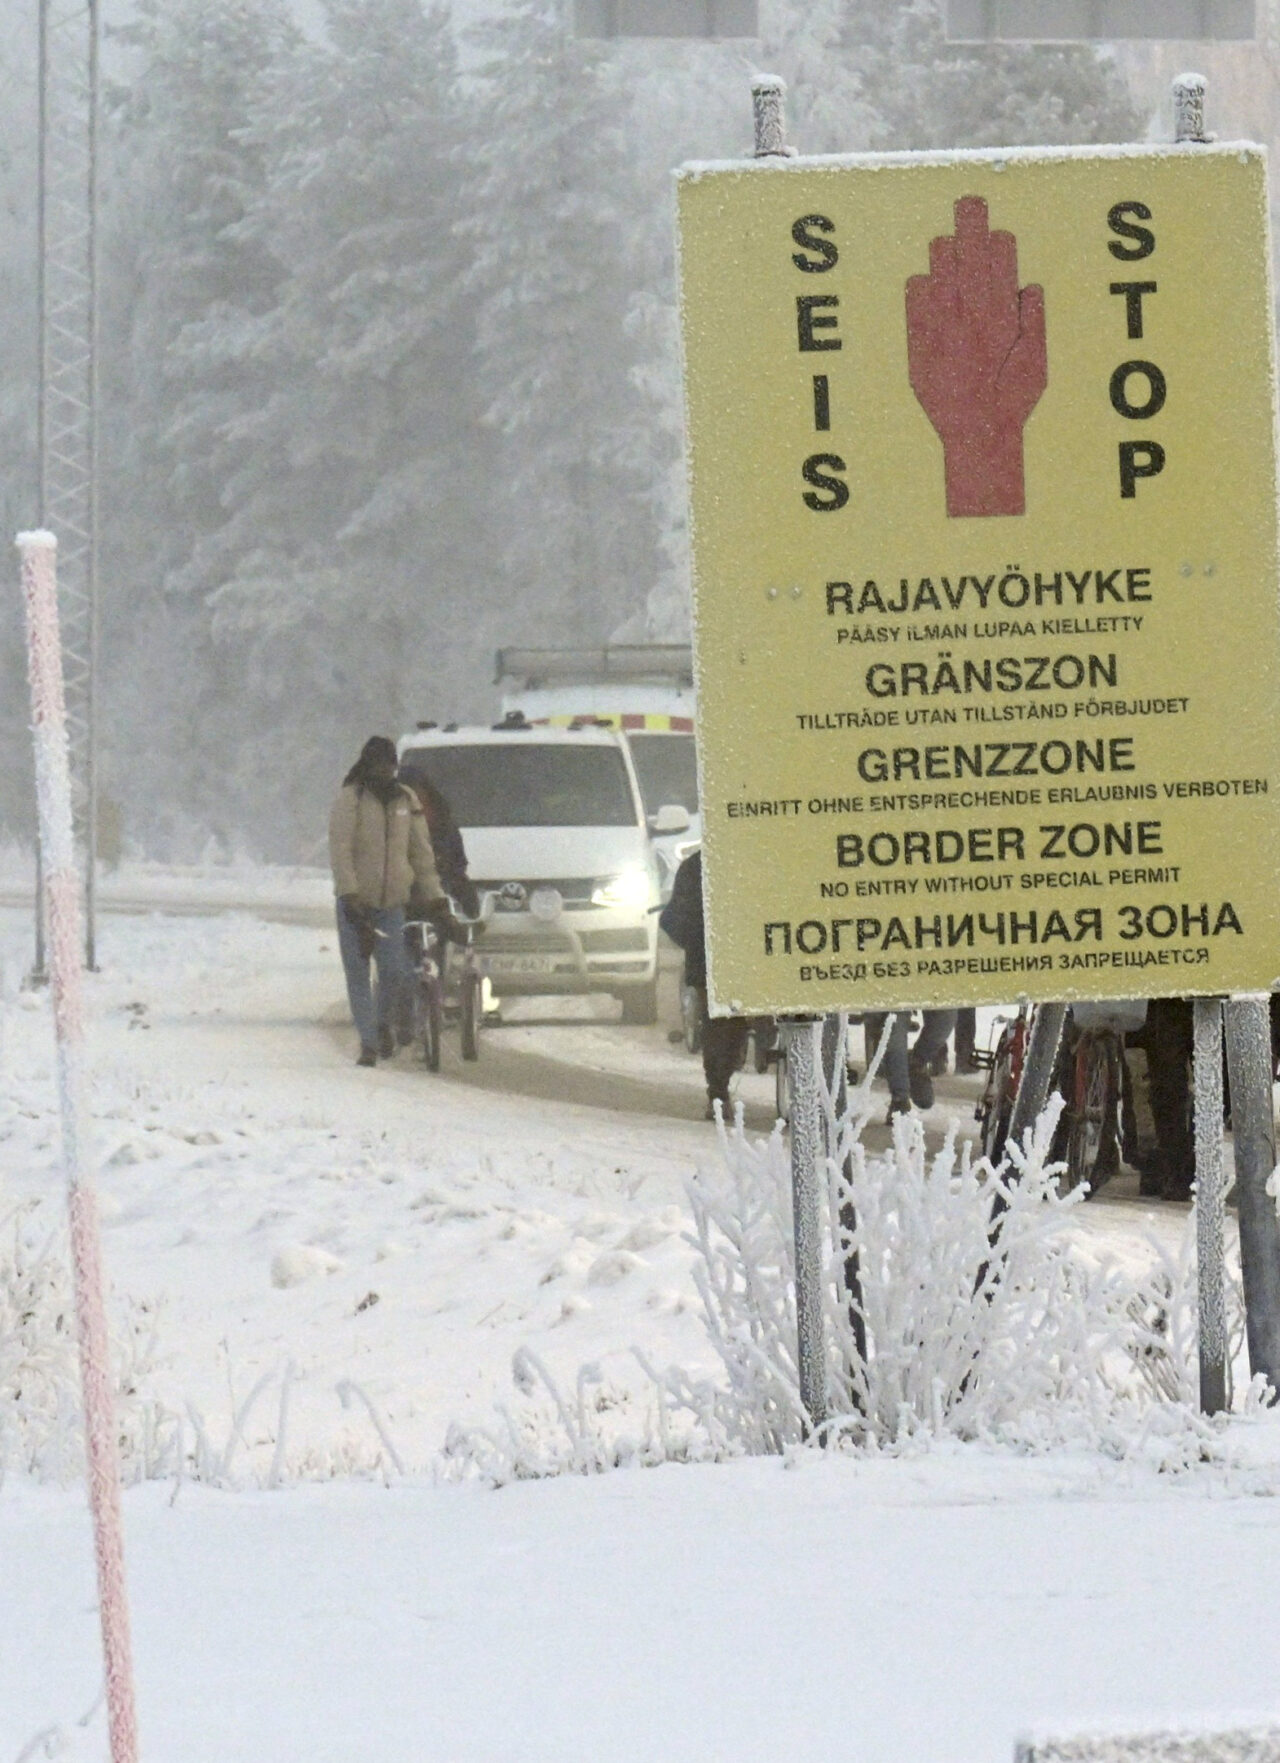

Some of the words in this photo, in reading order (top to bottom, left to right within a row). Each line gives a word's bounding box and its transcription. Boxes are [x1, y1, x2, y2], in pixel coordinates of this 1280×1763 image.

[791, 214, 850, 512] SEIS
[1107, 201, 1166, 499] STOP
[825, 565, 1153, 615] RAJAVYÖHYKE
[837, 625, 900, 644] PÄÄSY
[908, 622, 967, 641] ILMAN
[974, 620, 1036, 638] LUPAA
[1042, 616, 1143, 634] KIELLETTY
[865, 652, 1118, 697] GRÄNSZON
[796, 709, 899, 730] TILLTRÄDE
[905, 708, 957, 725] UTAN
[963, 700, 1068, 723] TILLSTÅND
[1074, 698, 1190, 718] FÖRBJUDET
[857, 738, 1135, 783] GRENZZONE
[727, 800, 802, 818] EINRITT
[808, 797, 864, 814] OHNE
[870, 789, 1040, 812] ENTSPRECHENDE
[1047, 784, 1157, 804] ERLAUBNIS
[1163, 778, 1269, 799] VERBOTEN
[837, 827, 1025, 868] BORDER
[1039, 821, 1164, 859] ZONE
[820, 881, 849, 898] NO
[856, 878, 918, 896] ENTRY
[925, 874, 1013, 894] WITHOUT
[1021, 870, 1103, 890] SPECIAL
[1108, 867, 1181, 886] PERMIT
[764, 907, 1103, 955] ПОГРАНИЧНАЯ
[1117, 902, 1244, 940] ЗОНА
[800, 961, 867, 982] ВЪЕЗД
[873, 959, 911, 978] БЕЗ
[917, 953, 1053, 975] РАЗРЕШЕНИЯ
[1058, 948, 1209, 970] ЗАПРЕЩАЕТСЯ
